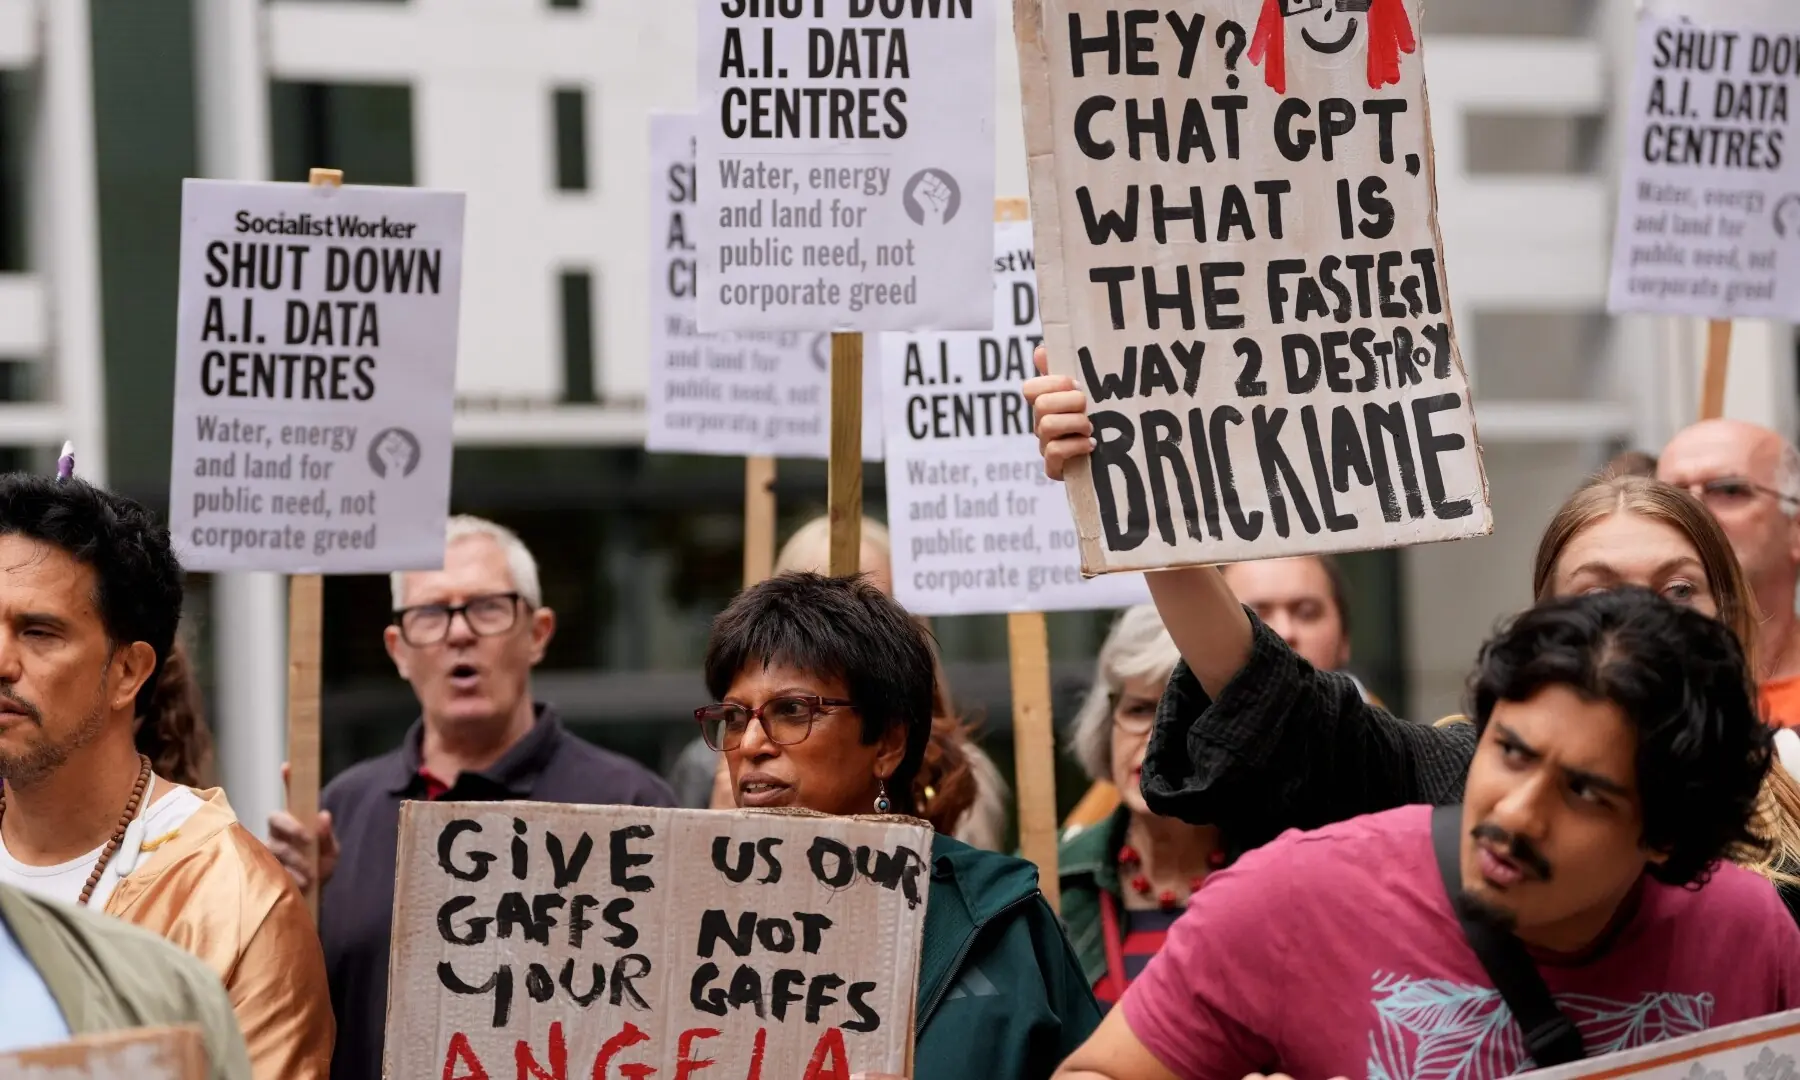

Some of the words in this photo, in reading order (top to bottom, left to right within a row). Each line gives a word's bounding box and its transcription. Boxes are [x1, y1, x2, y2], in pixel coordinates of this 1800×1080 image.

[719, 27, 788, 78] A.I.
[808, 28, 910, 79] DATA
[1068, 10, 1247, 90] HEY?
[1652, 27, 1739, 72] SHUT
[1750, 33, 1800, 78] DO
[721, 87, 908, 139] CENTRES
[1646, 76, 1699, 118] A.I.
[1713, 80, 1789, 123] DATA
[1073, 95, 1248, 163] CHAT
[1273, 97, 1420, 178] GPT,
[1643, 122, 1784, 170] CENTRES
[719, 159, 799, 193] Water,
[808, 167, 891, 196] energy
[719, 199, 762, 228] and
[772, 199, 818, 228] land
[830, 199, 867, 228] for
[1075, 179, 1291, 245] WHAT
[1336, 175, 1395, 240] IS
[205, 241, 309, 290] SHUT
[325, 246, 441, 294] DOWN
[719, 237, 793, 273] public
[803, 237, 867, 272] need,
[876, 239, 915, 266] not
[719, 279, 840, 312] corporate
[849, 275, 917, 312] greed
[1090, 261, 1245, 330] THE
[1267, 248, 1442, 324] FASTEST
[201, 297, 265, 343] A.I.
[285, 300, 379, 347] DATA
[200, 350, 375, 401] CENTRES
[903, 340, 962, 386] A.I.
[1077, 339, 1205, 404] WAY
[1233, 337, 1267, 397] 2
[1281, 322, 1453, 395] DESTROY
[196, 415, 271, 449] Water,
[280, 424, 357, 452] energy
[907, 391, 1034, 440] CENTR
[194, 451, 235, 478] and
[243, 452, 292, 480] land
[299, 453, 334, 481] for
[907, 458, 978, 486] Water,
[986, 459, 1056, 486] energ
[192, 485, 263, 518] public
[271, 488, 331, 518] need,
[340, 490, 376, 516] not
[909, 492, 948, 521] and
[954, 491, 999, 518] land
[1007, 489, 1038, 516] for
[191, 524, 305, 554] corporate
[313, 522, 376, 556] greed
[911, 527, 976, 562] public
[983, 524, 1042, 554] need,
[1049, 529, 1075, 550] no
[913, 564, 1018, 594] corporate
[711, 835, 783, 886] US
[806, 836, 926, 910] OUR
[436, 892, 639, 949] GAFFS
[696, 909, 833, 959] NOT
[689, 962, 882, 1033] GAFFS
